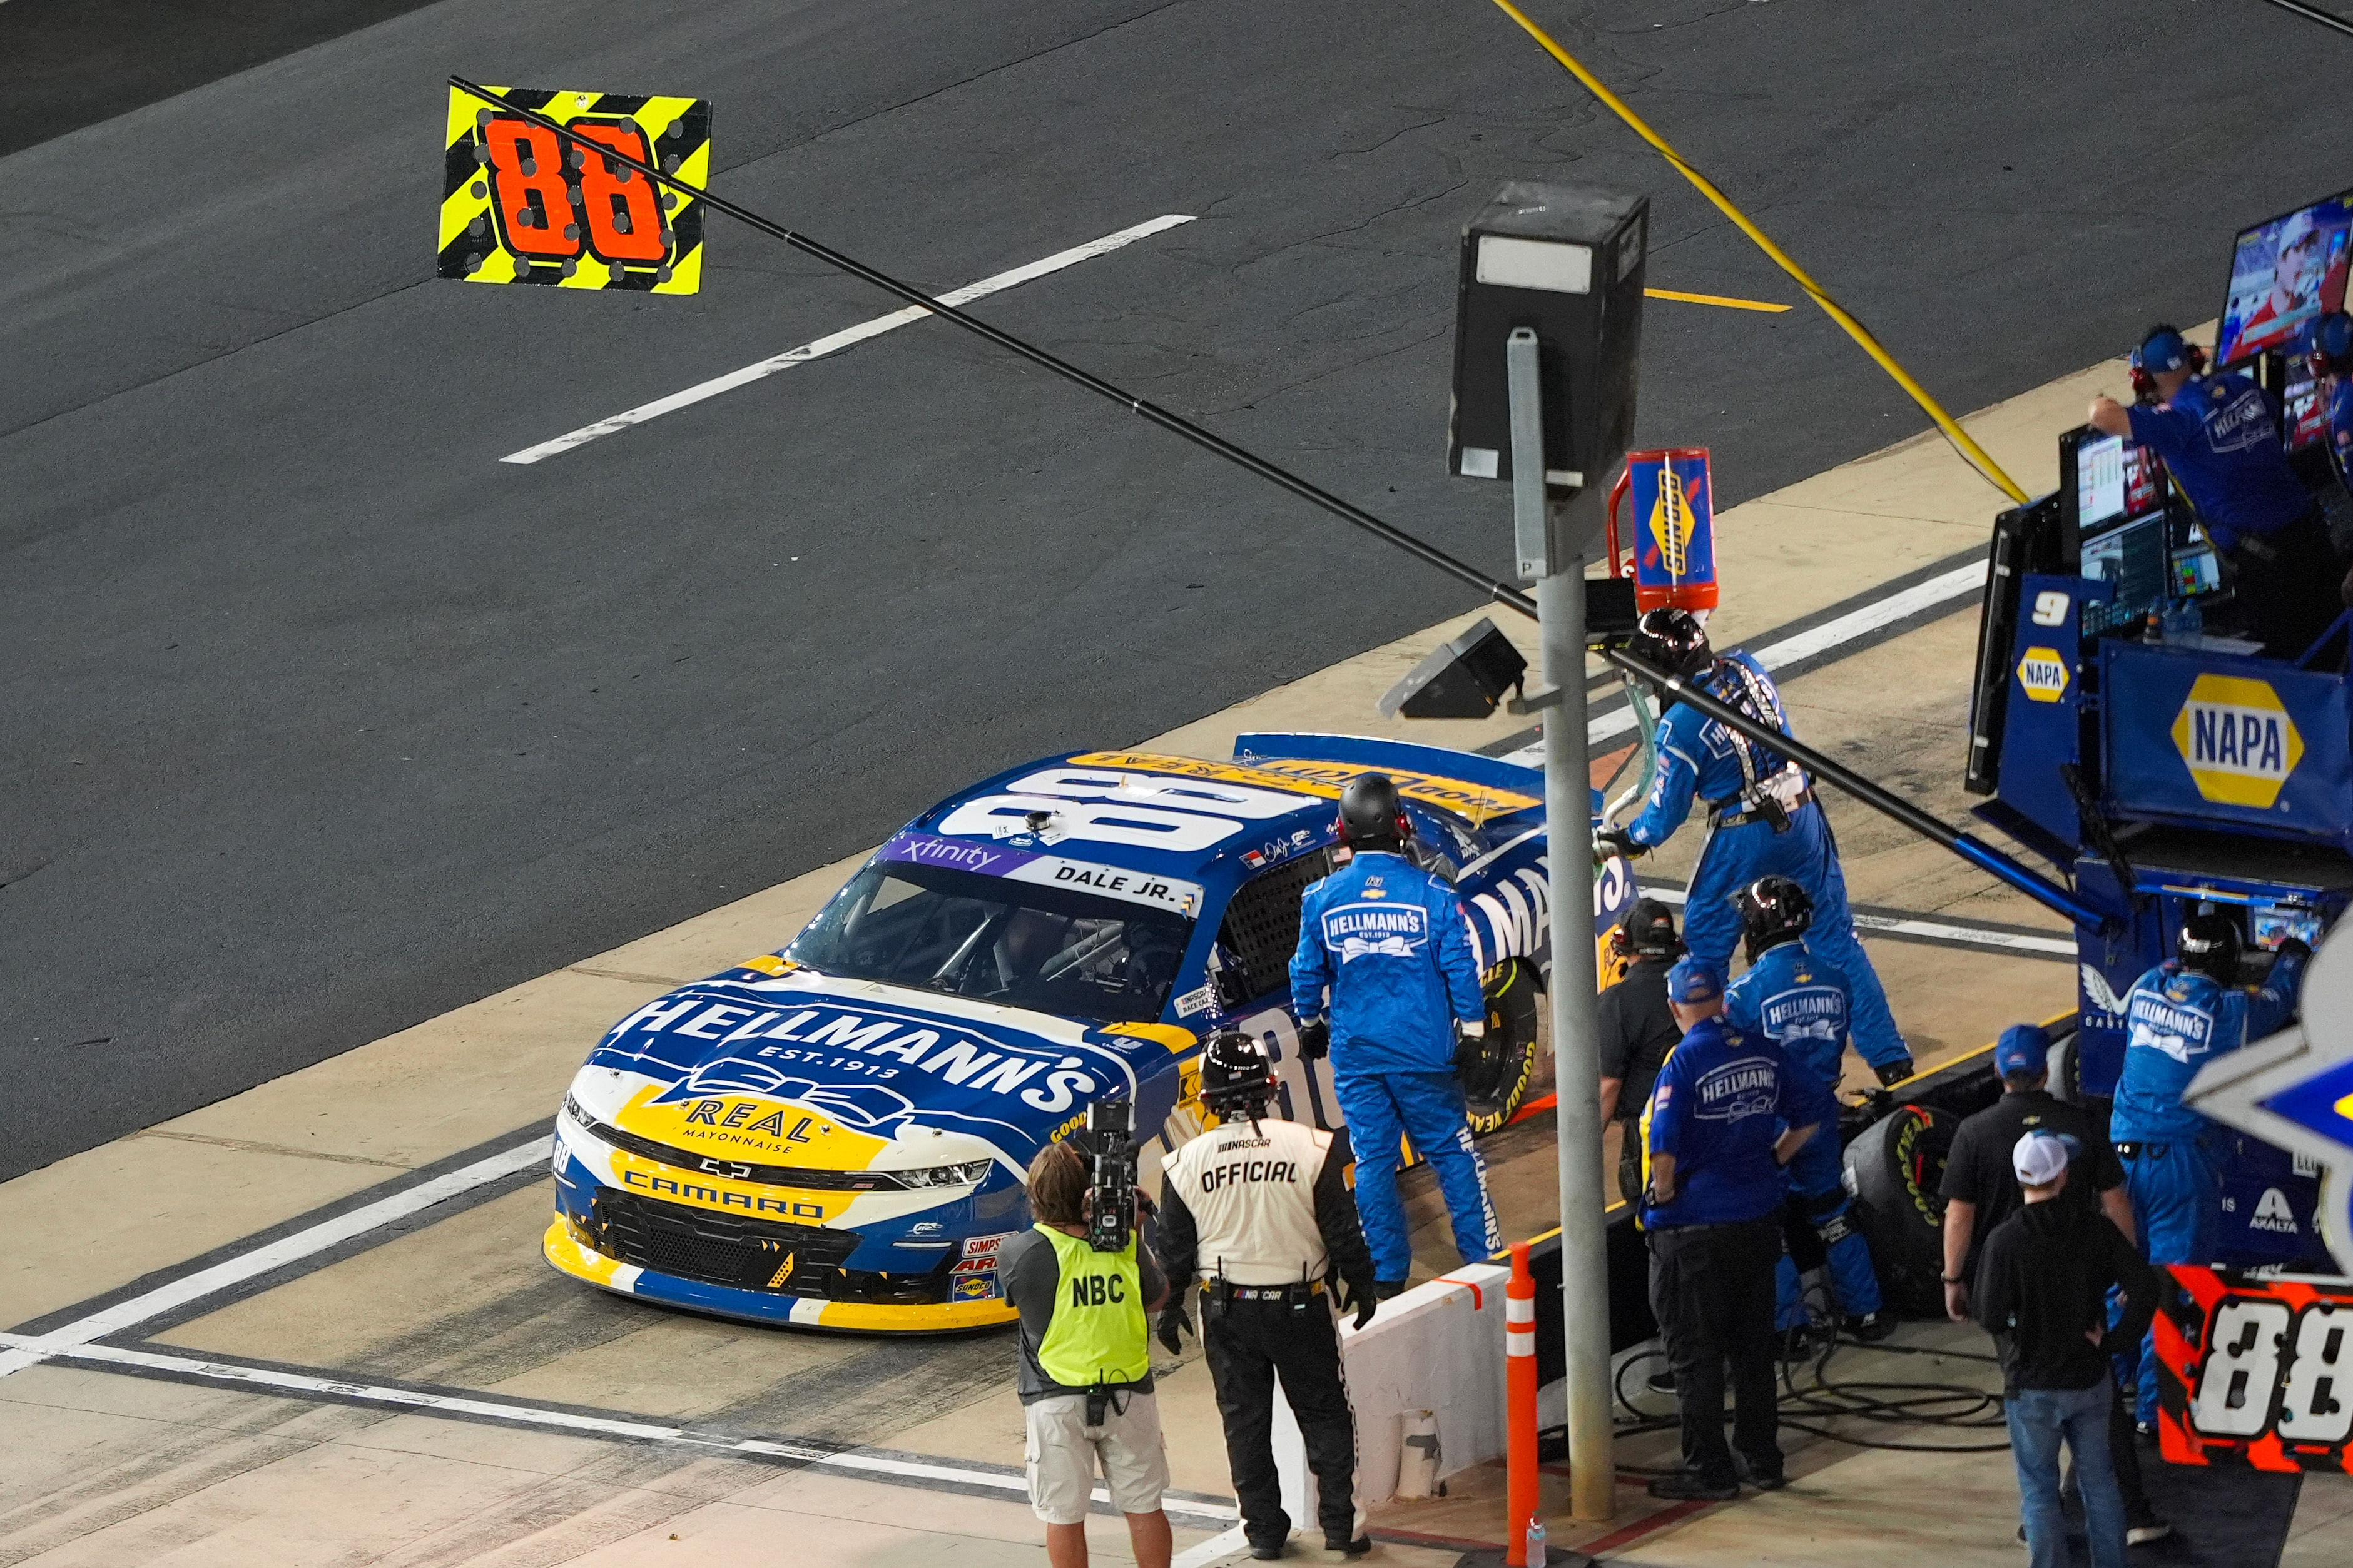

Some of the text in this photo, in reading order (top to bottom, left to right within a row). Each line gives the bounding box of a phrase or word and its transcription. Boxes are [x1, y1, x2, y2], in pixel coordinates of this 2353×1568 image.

[485, 116, 665, 261] 88
[1661, 473, 1684, 574] SUNOCO
[2031, 591, 2070, 627] 9
[2026, 661, 2061, 687] NAPA
[2195, 709, 2282, 772] NAPA
[938, 767, 1322, 852] 88
[901, 839, 1001, 871] xfinity
[1055, 866, 1176, 903] DALE JR.
[1329, 910, 1420, 937] HELLMANN'S
[1182, 1003, 1198, 1013] RACE
[1769, 993, 1842, 1026] HELLMANN'S
[607, 999, 1096, 1113] HELLMANN'S
[756, 1046, 900, 1078] EST.1913
[686, 1100, 813, 1144] REAL
[554, 1140, 573, 1174] 88
[683, 1129, 793, 1155] MAYONNAISE
[1231, 1137, 1271, 1150] NASCAR
[1201, 1161, 1296, 1193] OFFICIAL
[624, 1170, 823, 1219] CAMARO
[956, 1281, 991, 1293] SUNOCO
[1073, 1273, 1124, 1308] NBC
[2193, 1300, 2353, 1442] 88
